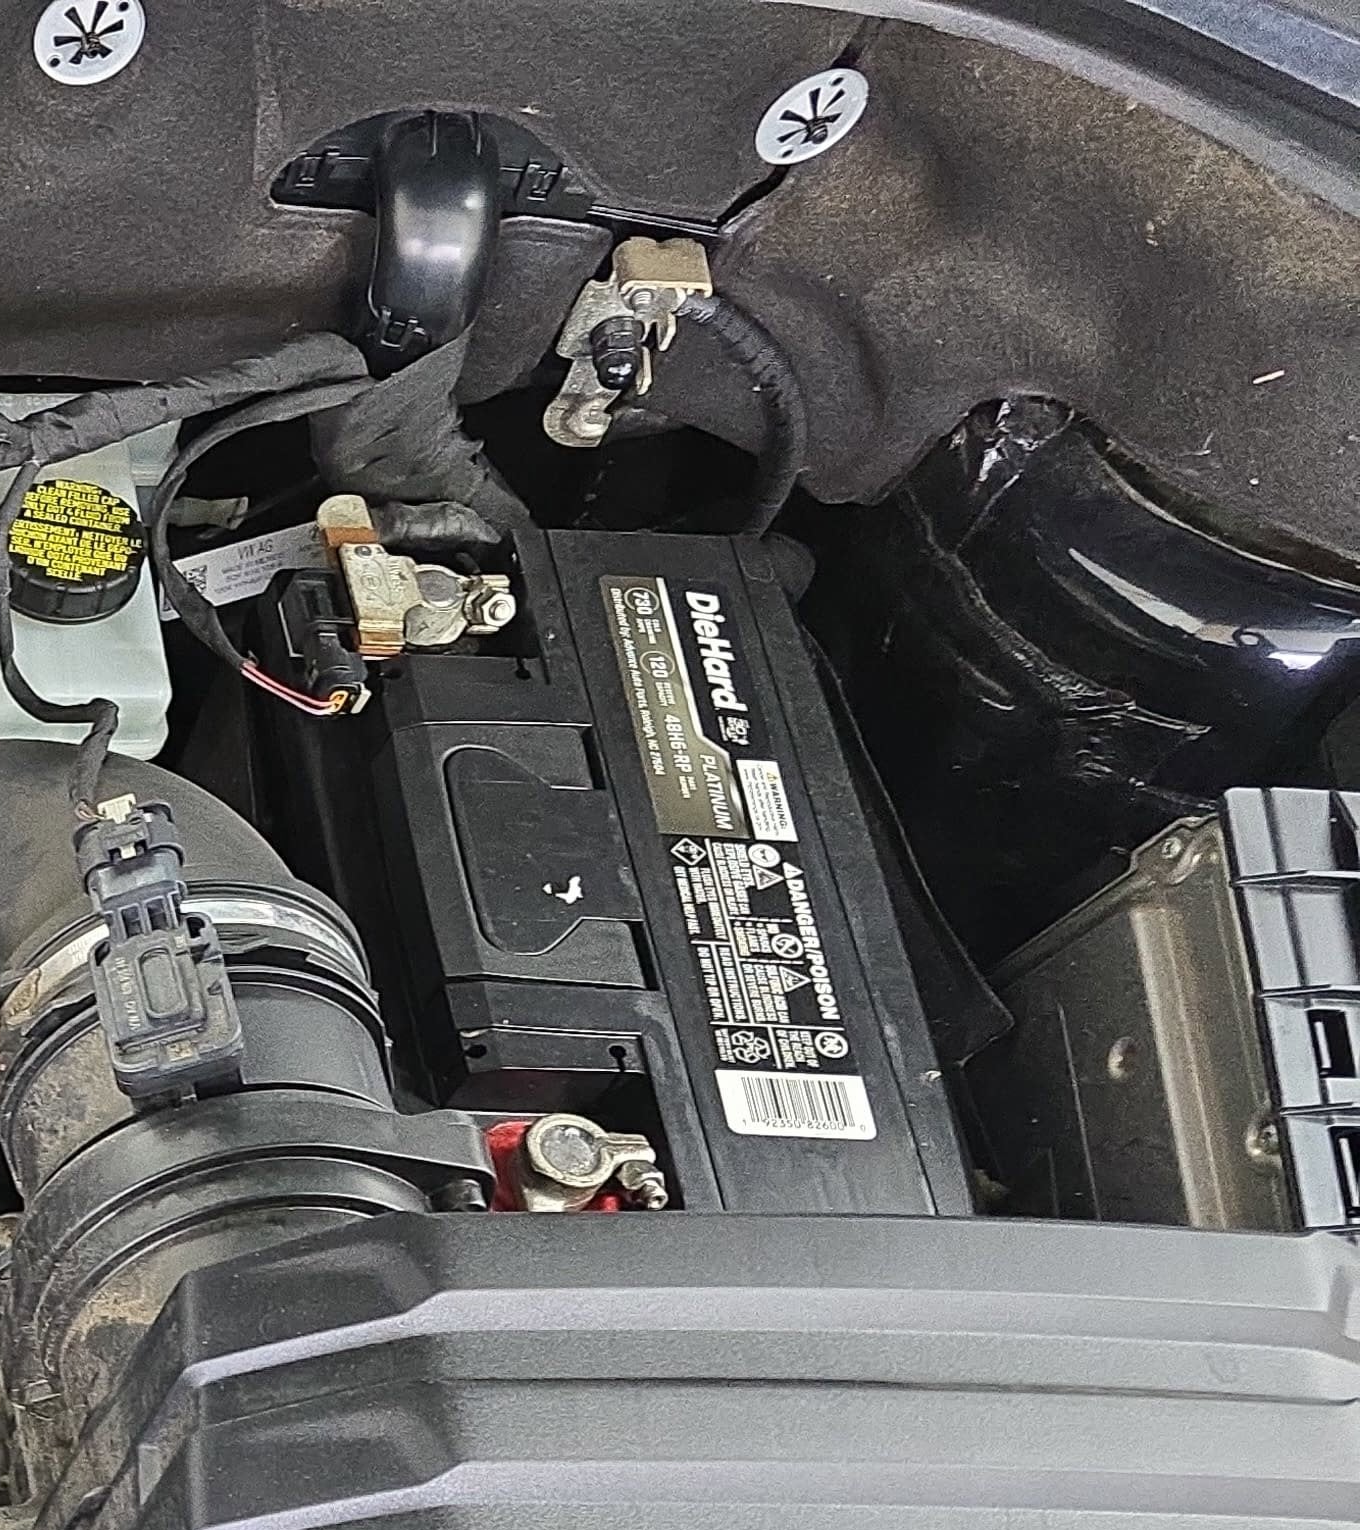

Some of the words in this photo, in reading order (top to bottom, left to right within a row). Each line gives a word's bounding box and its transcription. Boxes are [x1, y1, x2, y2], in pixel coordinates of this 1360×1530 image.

[37, 485, 66, 496] CLEAN
[68, 491, 99, 502] FILLER
[101, 495, 119, 505] CAP
[32, 511, 67, 522] SEALED
[130, 538, 141, 547] LE
[633, 592, 652, 614] 730
[686, 592, 748, 711] DieHard
[610, 588, 629, 626] Distributed
[623, 638, 637, 668] Advance
[630, 669, 642, 686] Auto
[647, 739, 659, 750] NC
[649, 656, 668, 677] 120
[664, 714, 691, 771] 48H6-RP
[699, 754, 732, 829] PLATINUM
[770, 783, 787, 828] WARNING:
[697, 947, 709, 957] DO
[719, 947, 732, 966] READ
[790, 879, 839, 1019] DANGER/POISON
[700, 958, 713, 972] NOT
[703, 974, 716, 985] TIP
[706, 986, 719, 997] OR
